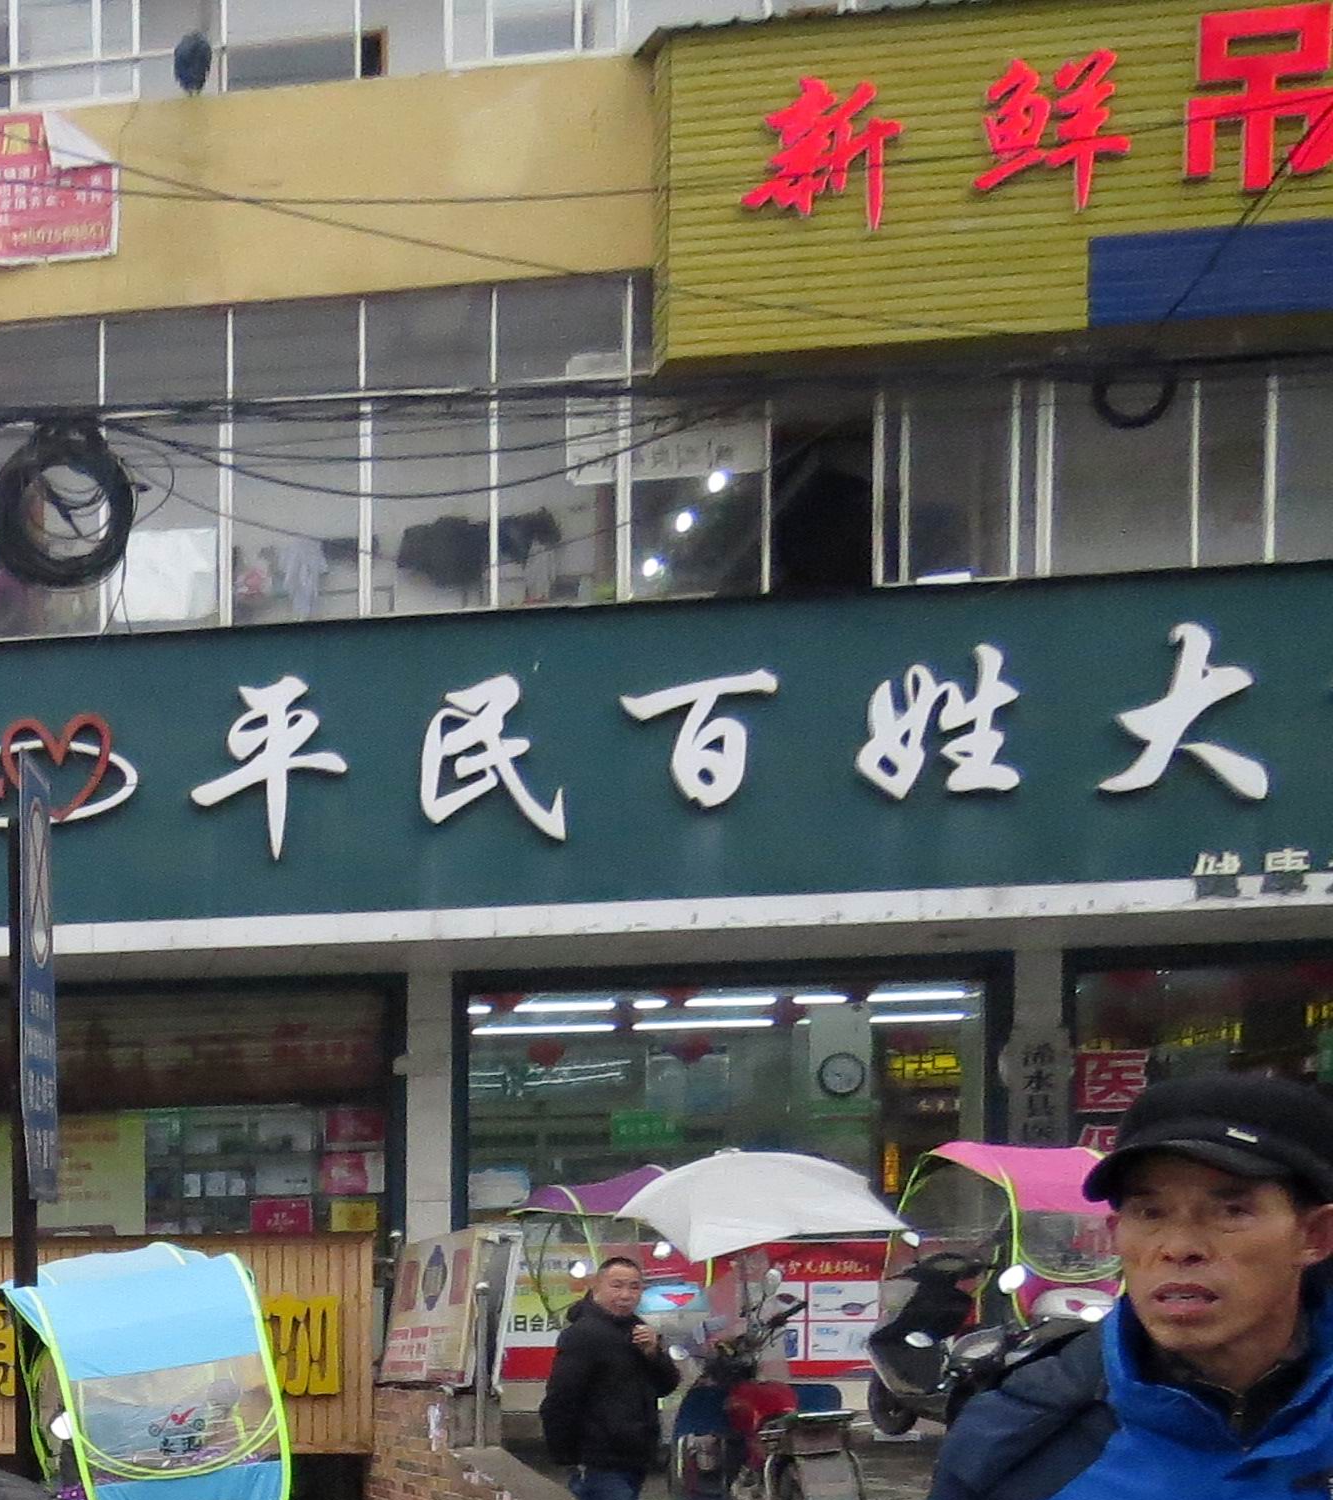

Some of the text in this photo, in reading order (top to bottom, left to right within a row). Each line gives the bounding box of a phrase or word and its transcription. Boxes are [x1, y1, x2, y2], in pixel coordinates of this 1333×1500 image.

[190, 622, 1270, 859] 平民百姓大
